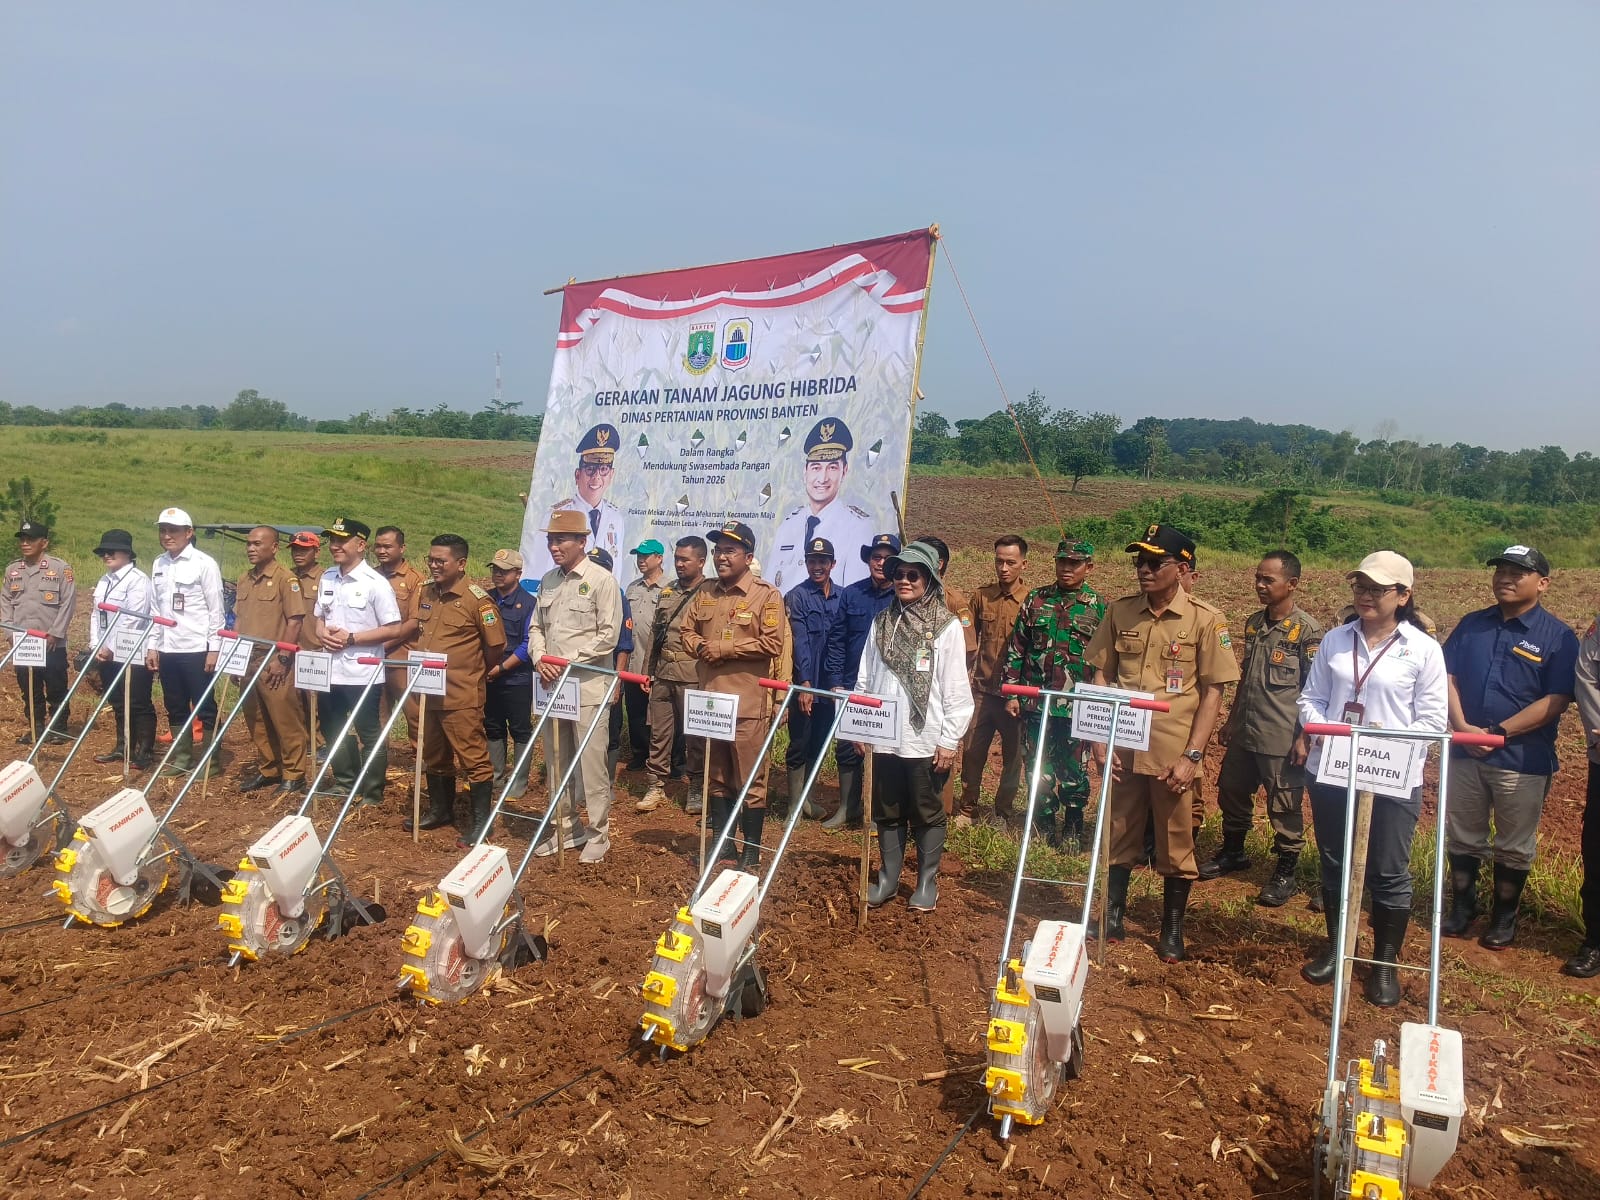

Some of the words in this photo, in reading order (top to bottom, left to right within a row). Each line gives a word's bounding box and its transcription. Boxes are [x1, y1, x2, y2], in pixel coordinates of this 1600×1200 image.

[594, 389, 660, 407] GERAKAN
[663, 386, 718, 404] TANAM
[721, 382, 786, 402] JAGUNG
[790, 375, 857, 398] HIBRIDA
[621, 411, 652, 424] DINAS
[654, 410, 714, 423] PERTANIAN
[716, 407, 768, 421] PROVINSI
[771, 403, 819, 419] BANTEN
[680, 448, 704, 457] Dalam
[706, 447, 735, 458] Rangka
[643, 461, 687, 472] Mendukung
[689, 461, 740, 471] Swasembada
[741, 461, 771, 472] Pangan
[682, 475, 704, 484] Tahun
[706, 475, 726, 485] 2026
[648, 508, 666, 516] Mekar
[727, 511, 759, 519] Kecamatan
[760, 511, 776, 520] Maja
[651, 519, 681, 529] Kabupaten
[682, 520, 698, 528] Lebak
[411, 667, 441, 678] GERNUR
[546, 692, 565, 700] KEUA
[537, 700, 552, 708] DPR
[1086, 704, 1111, 714] ASISTEN
[1114, 707, 1137, 718] ERAH
[704, 711, 731, 720] PERTANIAN
[845, 705, 873, 716] TENAGA
[874, 709, 891, 718] AHLI
[689, 717, 710, 725] PROVINSI
[711, 720, 731, 729] BANTEN
[852, 718, 883, 729] MENTERI
[1086, 713, 1136, 727] PEREKOMIAN
[1079, 720, 1093, 728] DAN
[1093, 722, 1142, 737] PEMBGUNAN
[1355, 747, 1391, 761] EPALA
[1334, 759, 1350, 770] BP
[1357, 763, 1401, 780] BANTEN
[3, 776, 35, 804] TANIKAYA
[108, 806, 145, 833] TANIKAYA
[279, 831, 310, 860] TANIKAYA
[474, 865, 504, 900] TANIKAYA
[1044, 924, 1068, 969] TANIKAYA
[1427, 1030, 1441, 1092] TANIKAYA
